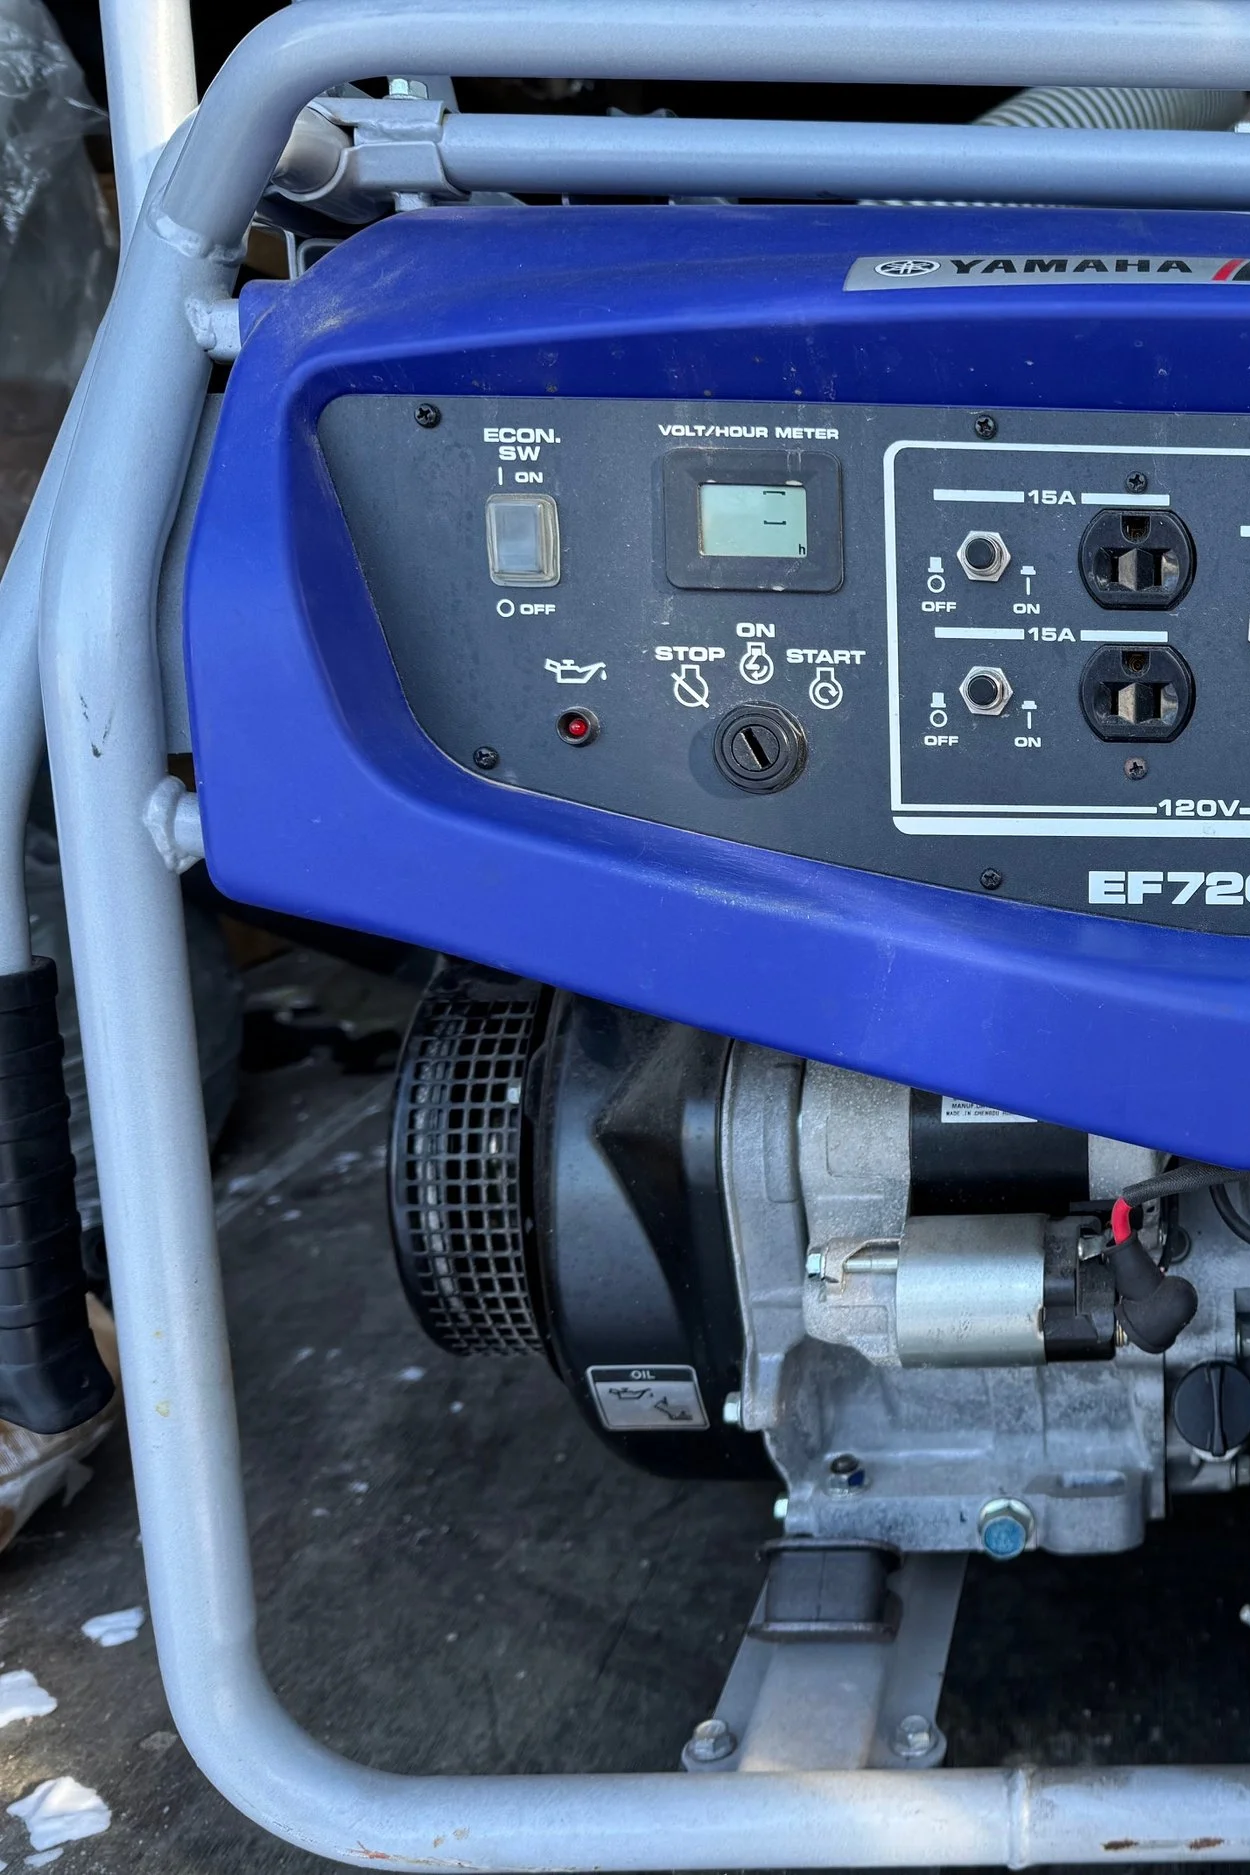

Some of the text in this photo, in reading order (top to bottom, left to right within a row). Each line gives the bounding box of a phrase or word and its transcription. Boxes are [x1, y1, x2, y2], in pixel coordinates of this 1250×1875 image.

[950, 259, 1193, 275] YAMAHA
[483, 427, 562, 444] ECON.
[657, 423, 840, 440] VOLT/HOUR METER
[498, 445, 541, 462] SW
[514, 471, 544, 484] ON
[1027, 489, 1077, 506] 15A
[519, 603, 556, 616] OFF
[921, 600, 957, 613] OFF
[1012, 602, 1041, 615] ON
[735, 622, 776, 638] ON
[1027, 626, 1077, 643] 15A
[653, 645, 726, 662] STOP
[785, 648, 867, 665] START
[923, 735, 959, 747] OFF
[1014, 736, 1042, 748] ON
[1157, 799, 1240, 817] 120V
[630, 1370, 656, 1380] OIL
